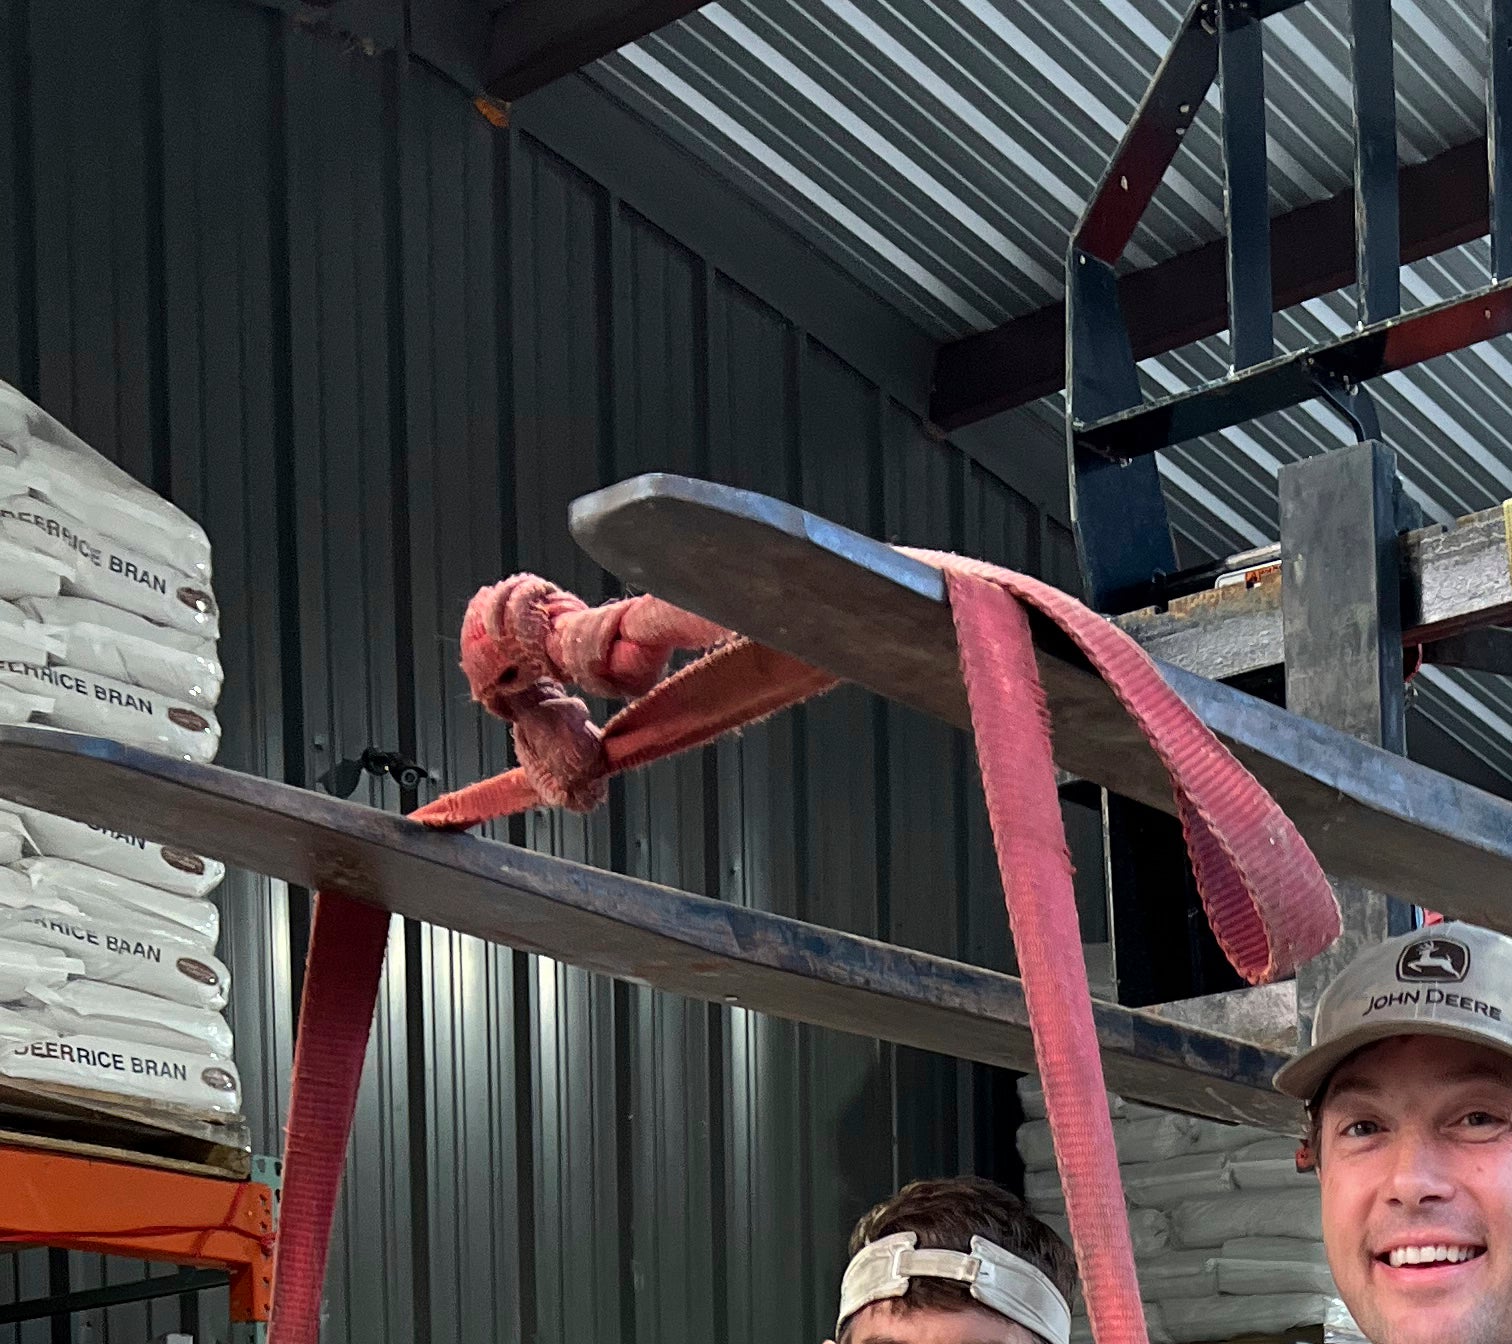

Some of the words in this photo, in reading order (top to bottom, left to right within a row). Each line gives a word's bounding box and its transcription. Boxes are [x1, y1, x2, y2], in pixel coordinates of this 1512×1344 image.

[109, 555, 167, 595] BRAN
[94, 684, 154, 715] BRAN
[106, 935, 162, 963] BRAN
[1362, 989, 1421, 1017] JOHN
[1425, 988, 1503, 1022] DEERE
[131, 1057, 188, 1081] BRAN
